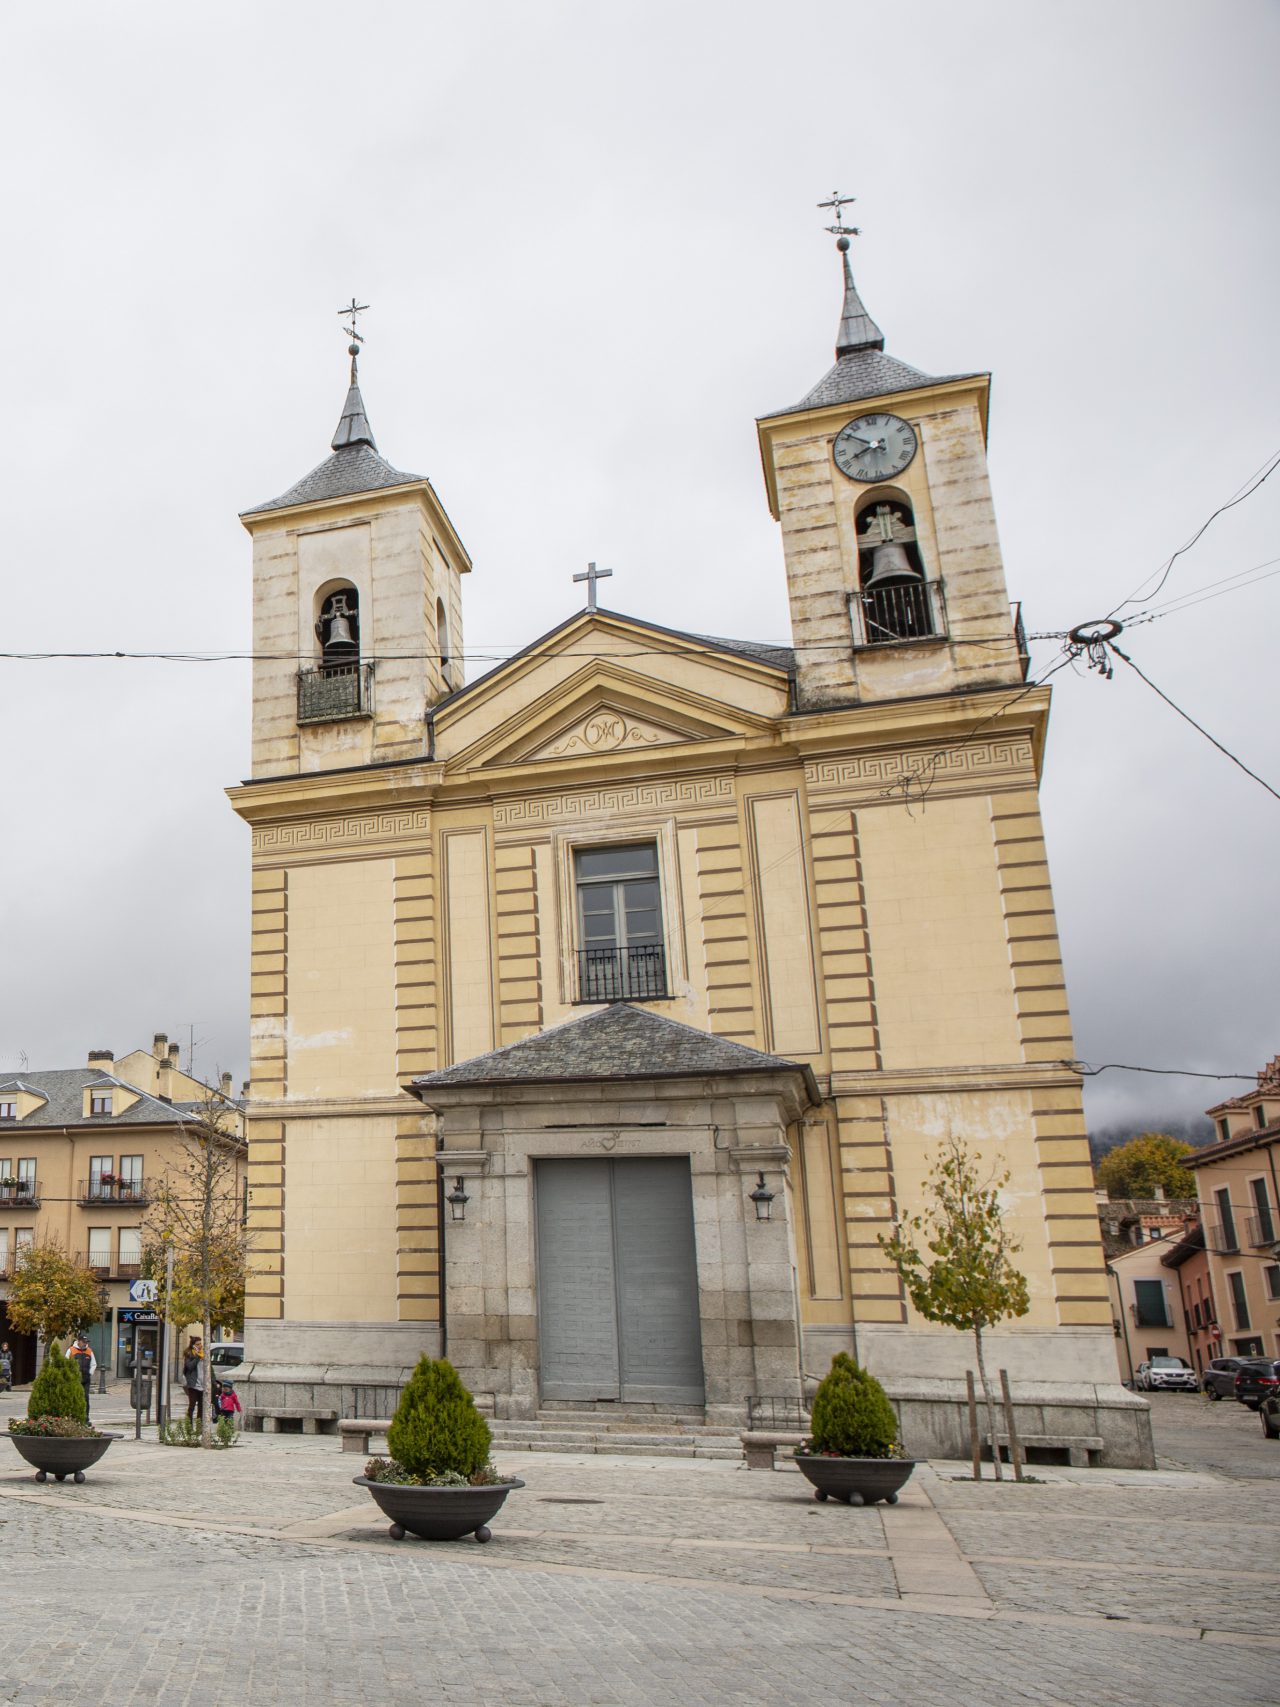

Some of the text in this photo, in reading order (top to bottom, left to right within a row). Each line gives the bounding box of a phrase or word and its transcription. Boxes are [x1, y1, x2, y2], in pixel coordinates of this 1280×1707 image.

[865, 417, 877, 426] XII
[885, 417, 890, 426] I
[849, 423, 861, 432] XI
[897, 425, 905, 433] II
[903, 437, 913, 446] III
[134, 1312, 159, 1320] CaixaBa
